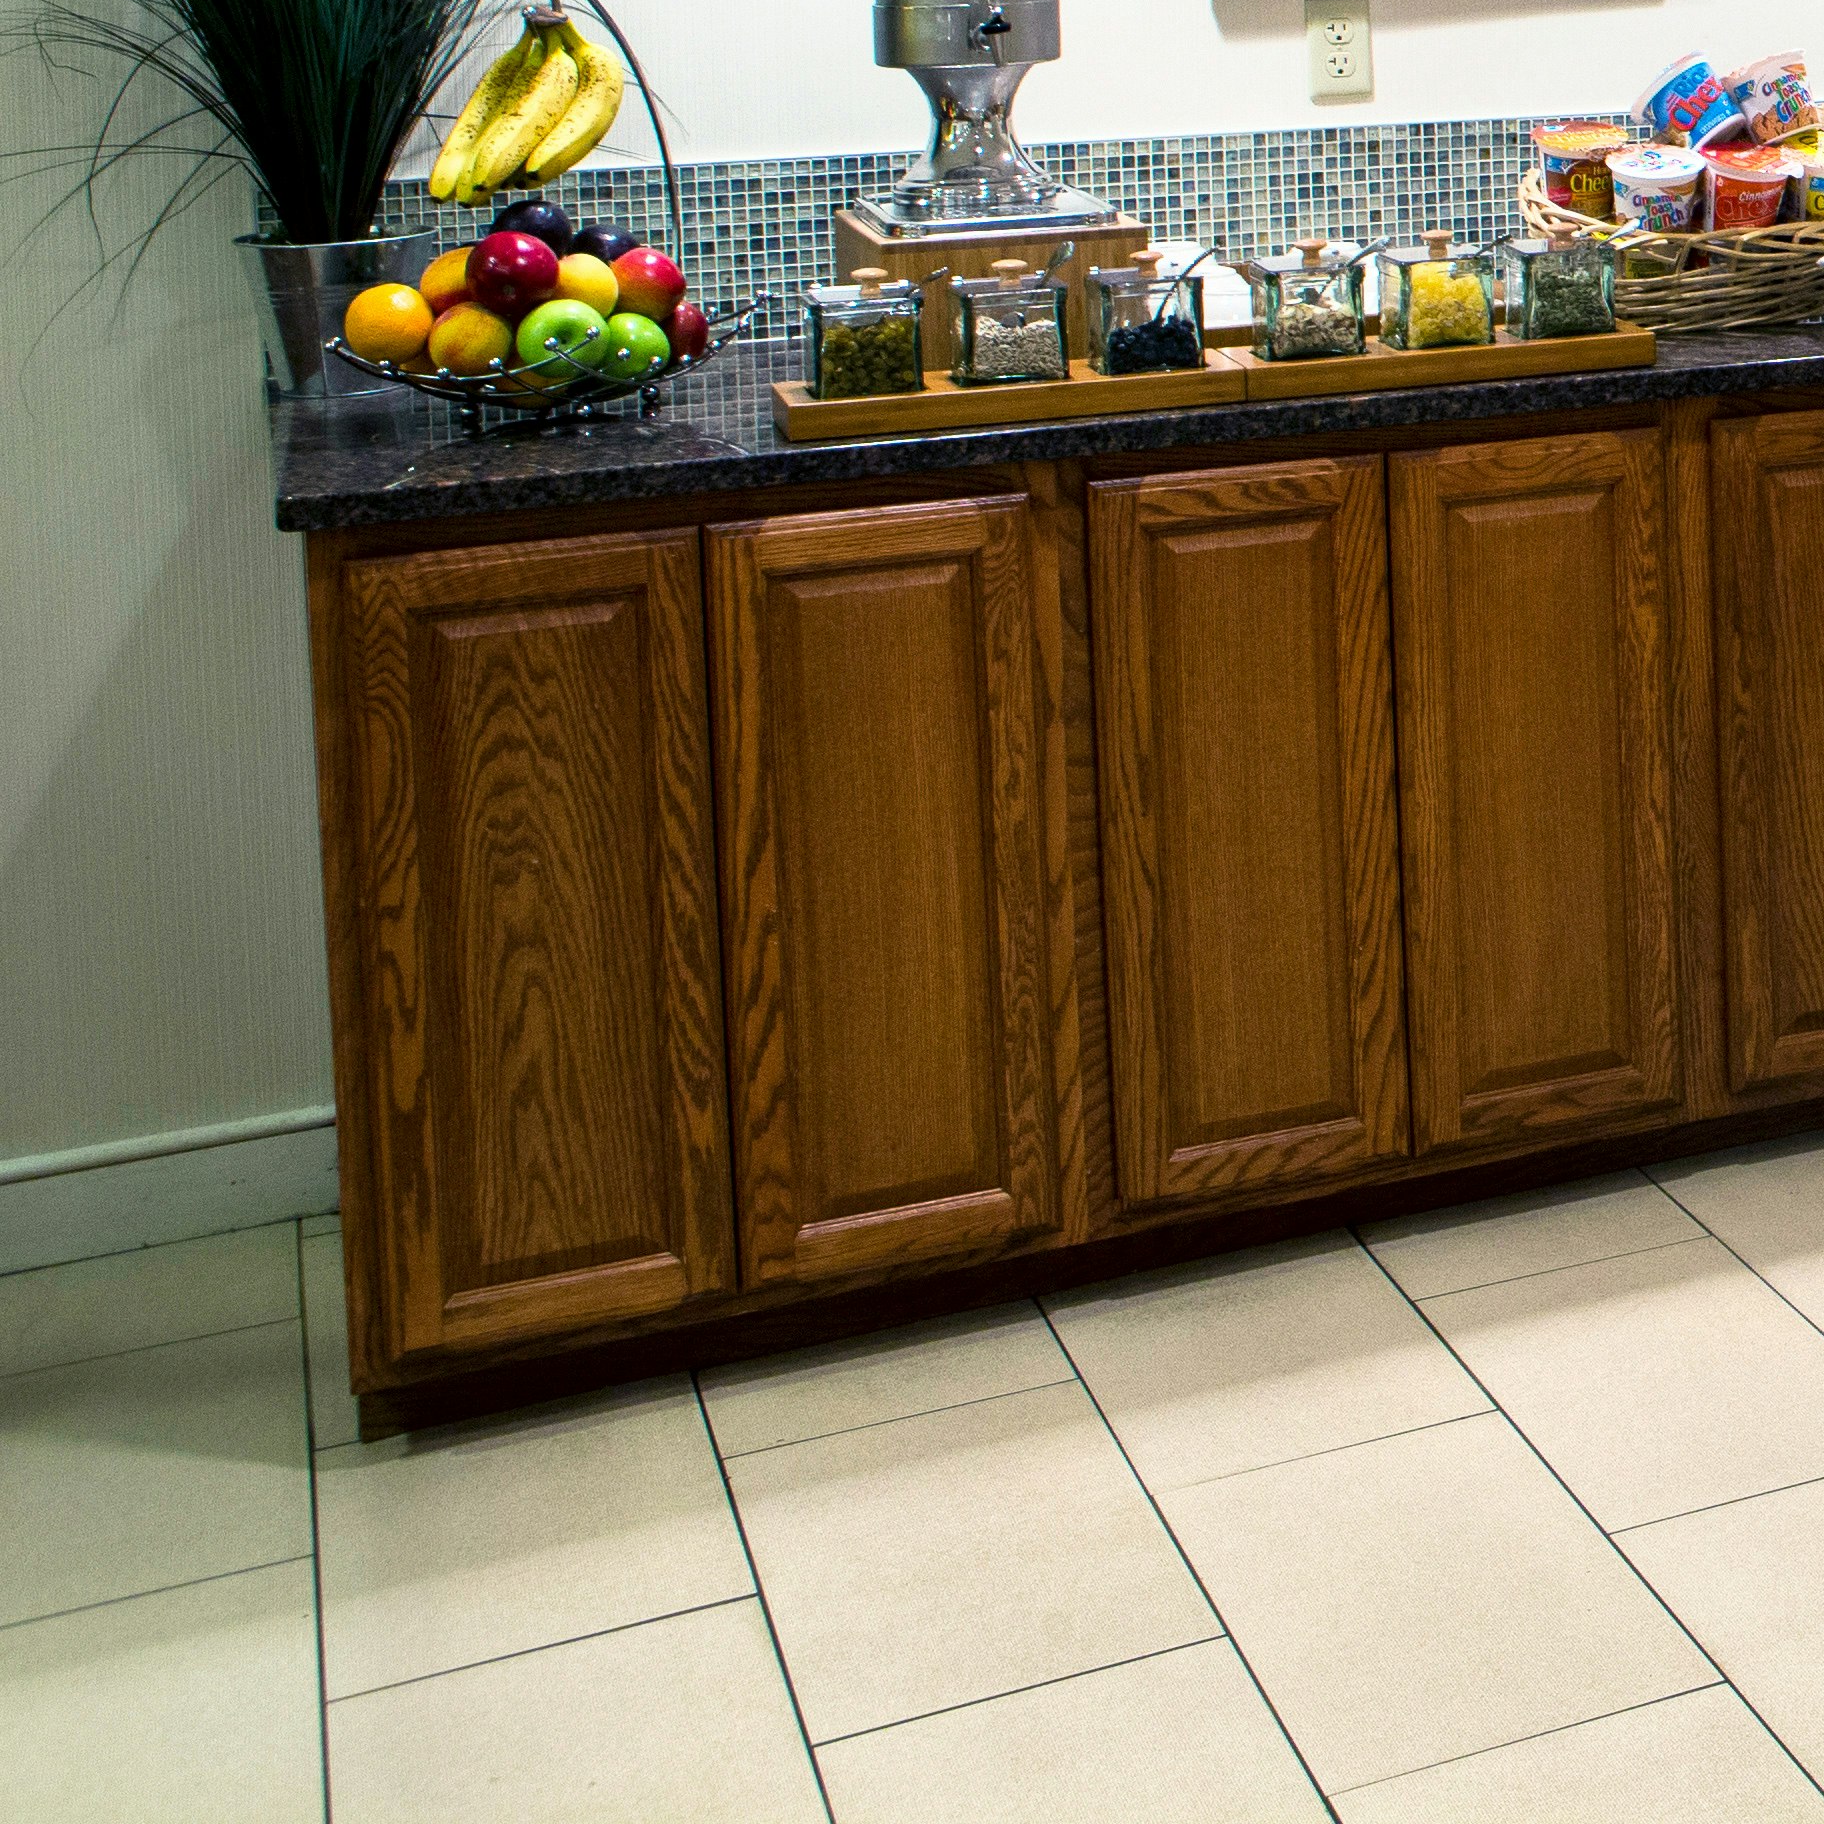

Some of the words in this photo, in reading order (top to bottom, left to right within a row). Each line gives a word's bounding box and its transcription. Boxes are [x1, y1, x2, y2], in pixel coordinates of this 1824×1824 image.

[1776, 81, 1803, 102] Toast
[1775, 88, 1812, 124] Crunch
[1644, 202, 1673, 217] Toast
